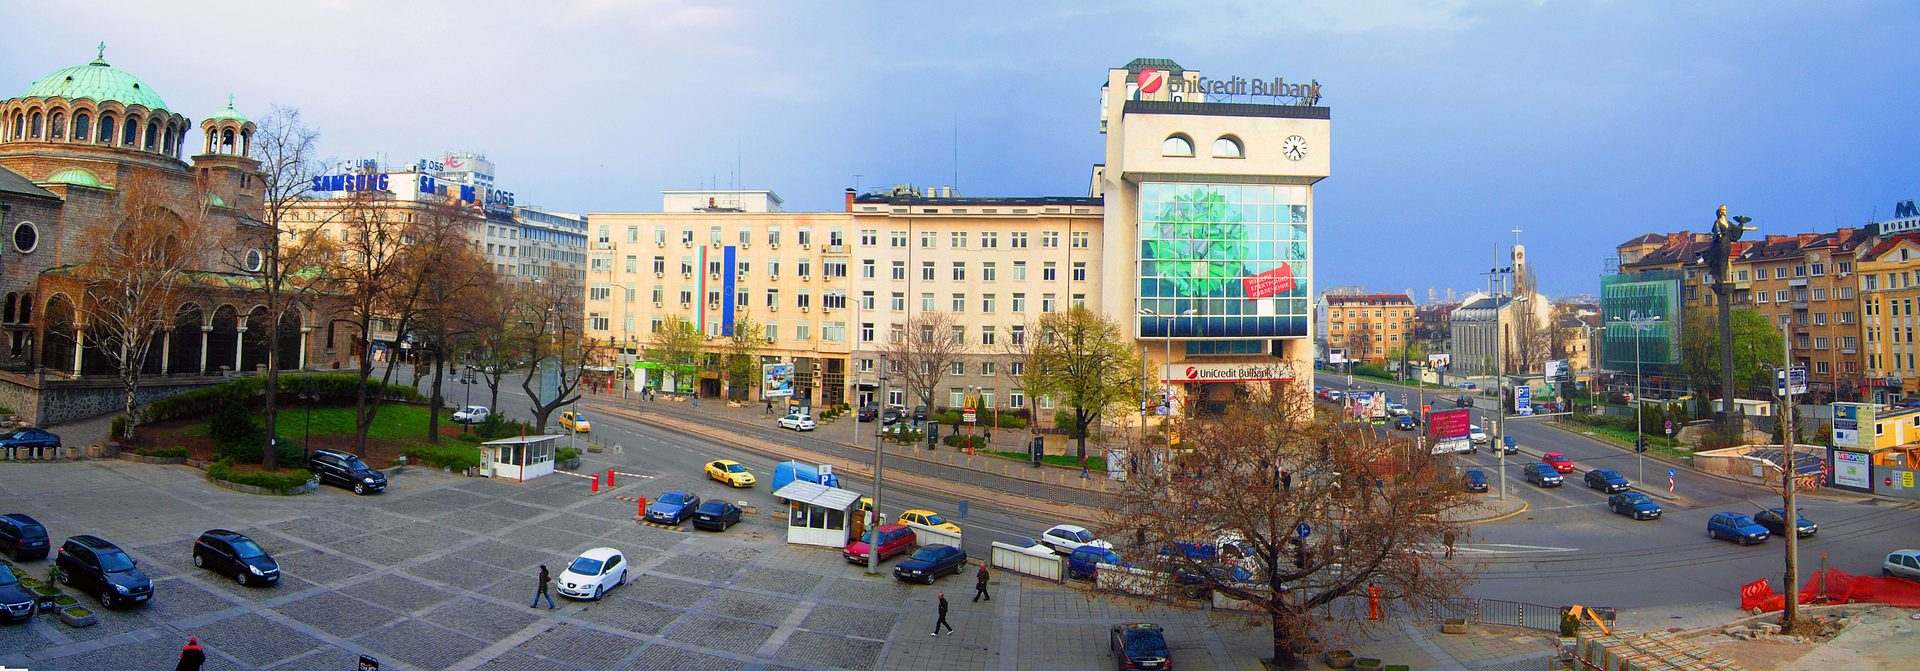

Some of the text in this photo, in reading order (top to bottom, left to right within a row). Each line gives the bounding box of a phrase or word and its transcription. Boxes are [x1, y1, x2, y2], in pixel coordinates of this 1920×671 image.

[1168, 75, 1322, 97] UniCredit Bulbank
[312, 173, 389, 193] SAMSUNG
[494, 189, 515, 206] ОББ
[1200, 368, 1272, 378] UniCredit Bulbank
[821, 475, 829, 487] P
